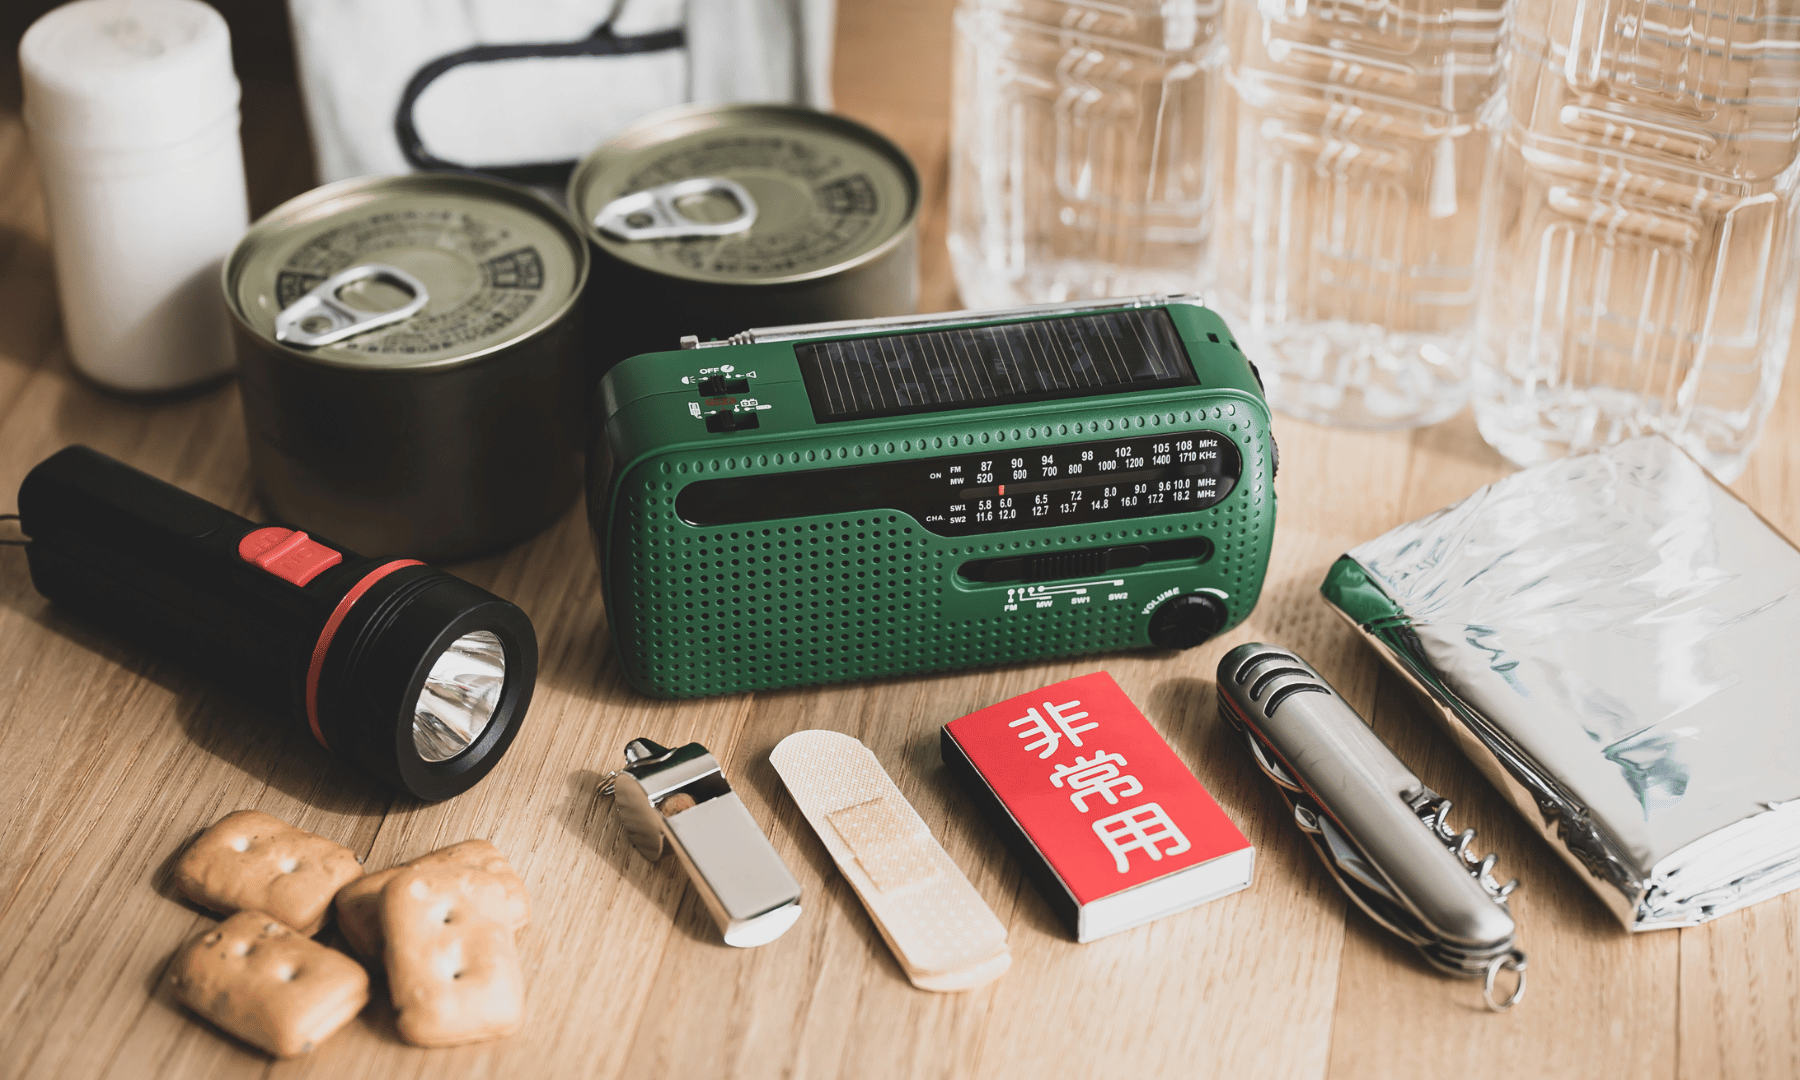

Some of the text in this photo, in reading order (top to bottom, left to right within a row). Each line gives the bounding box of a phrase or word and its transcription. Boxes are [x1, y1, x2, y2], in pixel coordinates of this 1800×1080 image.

[977, 473, 993, 483] 520
[1013, 469, 1027, 480] 600
[1042, 466, 1057, 476] 700
[1069, 464, 1082, 474] 800
[1098, 460, 1116, 470] 1000
[1126, 457, 1143, 468] 1200
[1153, 454, 1170, 465] 1400
[1179, 452, 1196, 462] 1710
[1199, 451, 1216, 460] KHz
[981, 461, 992, 471] 87
[1011, 458, 1023, 468] 90
[1042, 455, 1053, 465] 94
[1082, 451, 1093, 461] 98
[1115, 447, 1131, 457] 102
[1153, 443, 1169, 453] 105
[1176, 440, 1192, 451] 108
[1200, 439, 1217, 448] MHz
[976, 511, 992, 522] 11.6
[999, 509, 1016, 519] 12.0
[1032, 505, 1049, 516] 12.7
[1060, 503, 1077, 513] 13.7
[1091, 499, 1108, 510] 14.8
[1121, 496, 1137, 506] 16.0
[1148, 493, 1163, 503] 17.2
[1173, 491, 1189, 501] 18.2
[1197, 490, 1215, 498] MHz
[979, 500, 991, 510] 5.8
[1000, 498, 1012, 508] 6.0
[1035, 494, 1047, 504] 6.5
[1071, 491, 1082, 500] 7.2
[1105, 487, 1116, 497] 8.0
[1135, 484, 1146, 494] 9.0
[1159, 481, 1171, 491] 9.6
[1174, 479, 1190, 489] 10.0
[1198, 478, 1216, 486] MHz
[279, 547, 316, 571] ON
[1071, 596, 1090, 604] SW1
[1108, 592, 1128, 600] SW2
[1141, 587, 1180, 615] VOLUME
[1008, 700, 1191, 873] 非常用
